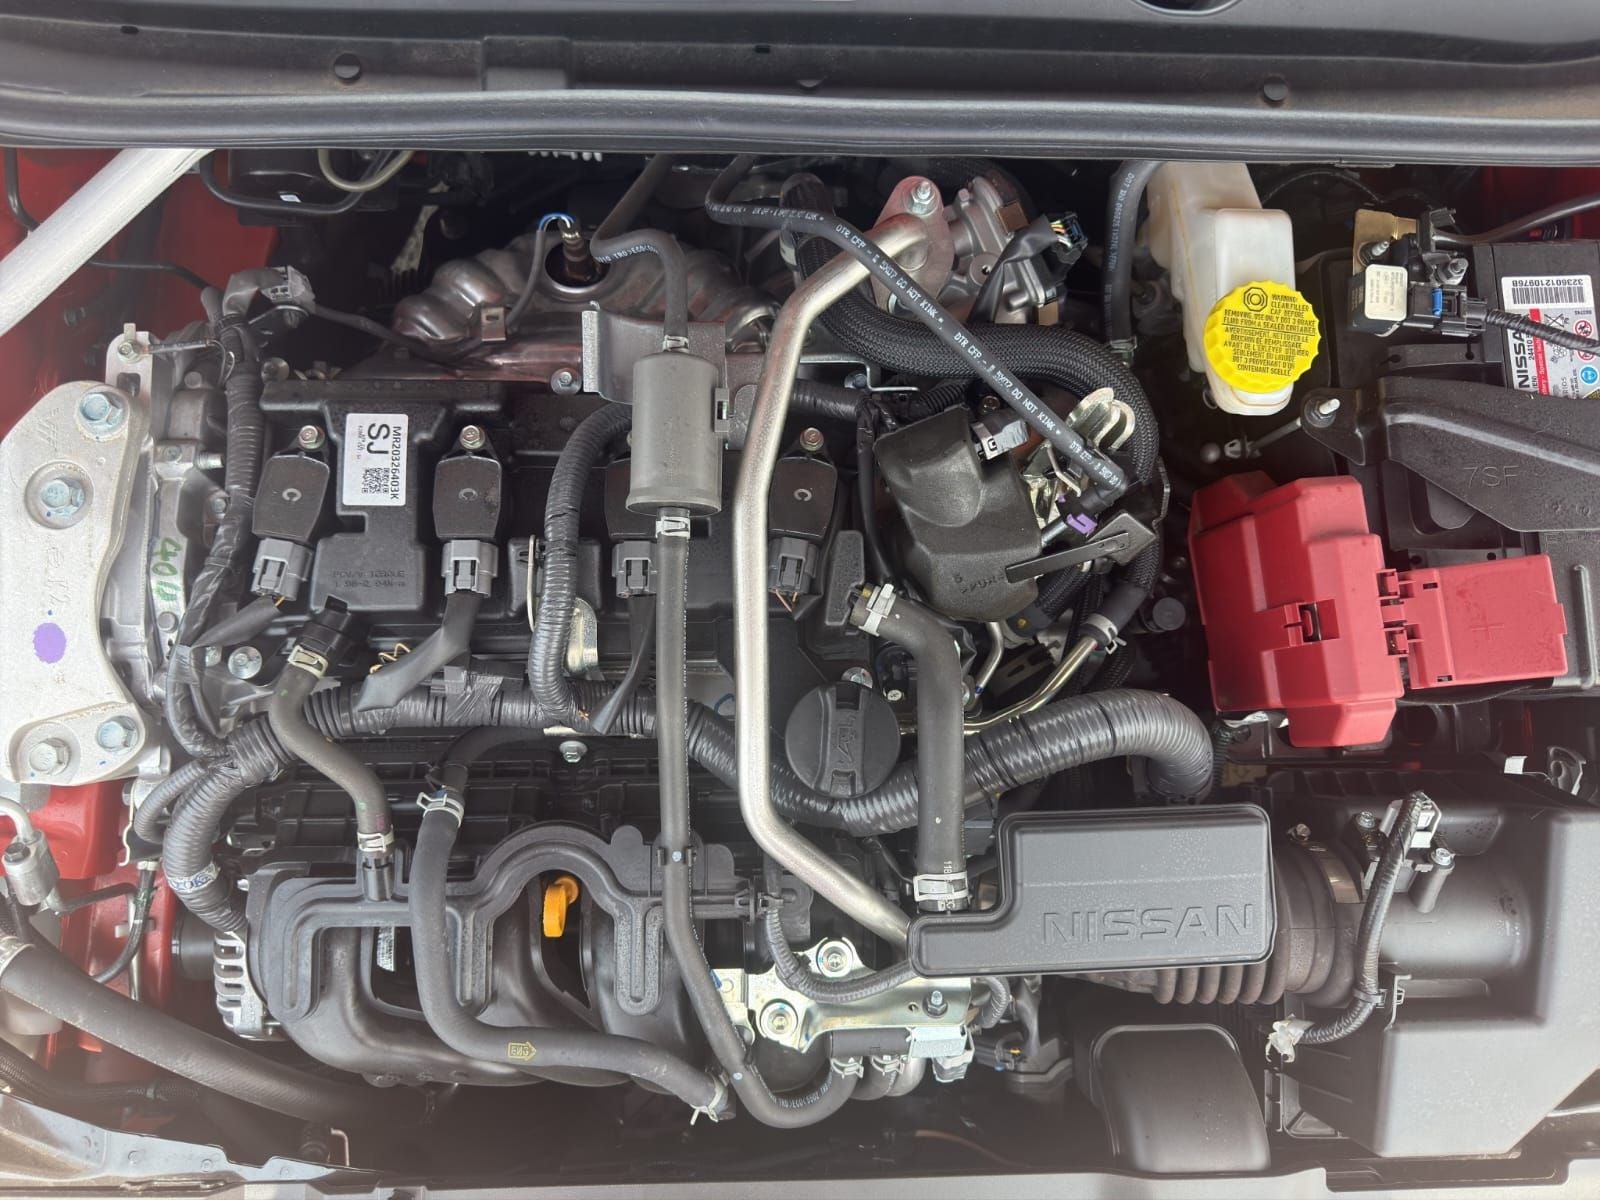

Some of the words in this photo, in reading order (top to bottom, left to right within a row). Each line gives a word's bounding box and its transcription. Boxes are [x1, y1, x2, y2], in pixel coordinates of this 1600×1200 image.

[906, 286, 921, 302] NOT
[919, 299, 938, 318] KINK
[1512, 329, 1530, 389] NISSA
[953, 331, 969, 347] DTR
[1010, 387, 1023, 400] DO
[1021, 398, 1037, 414] NOT
[1036, 412, 1055, 430] KINK
[366, 423, 390, 454] SJ
[390, 426, 402, 499] MR20326403K
[1463, 465, 1520, 488] 7SF
[1043, 904, 1253, 944] NISSAN
